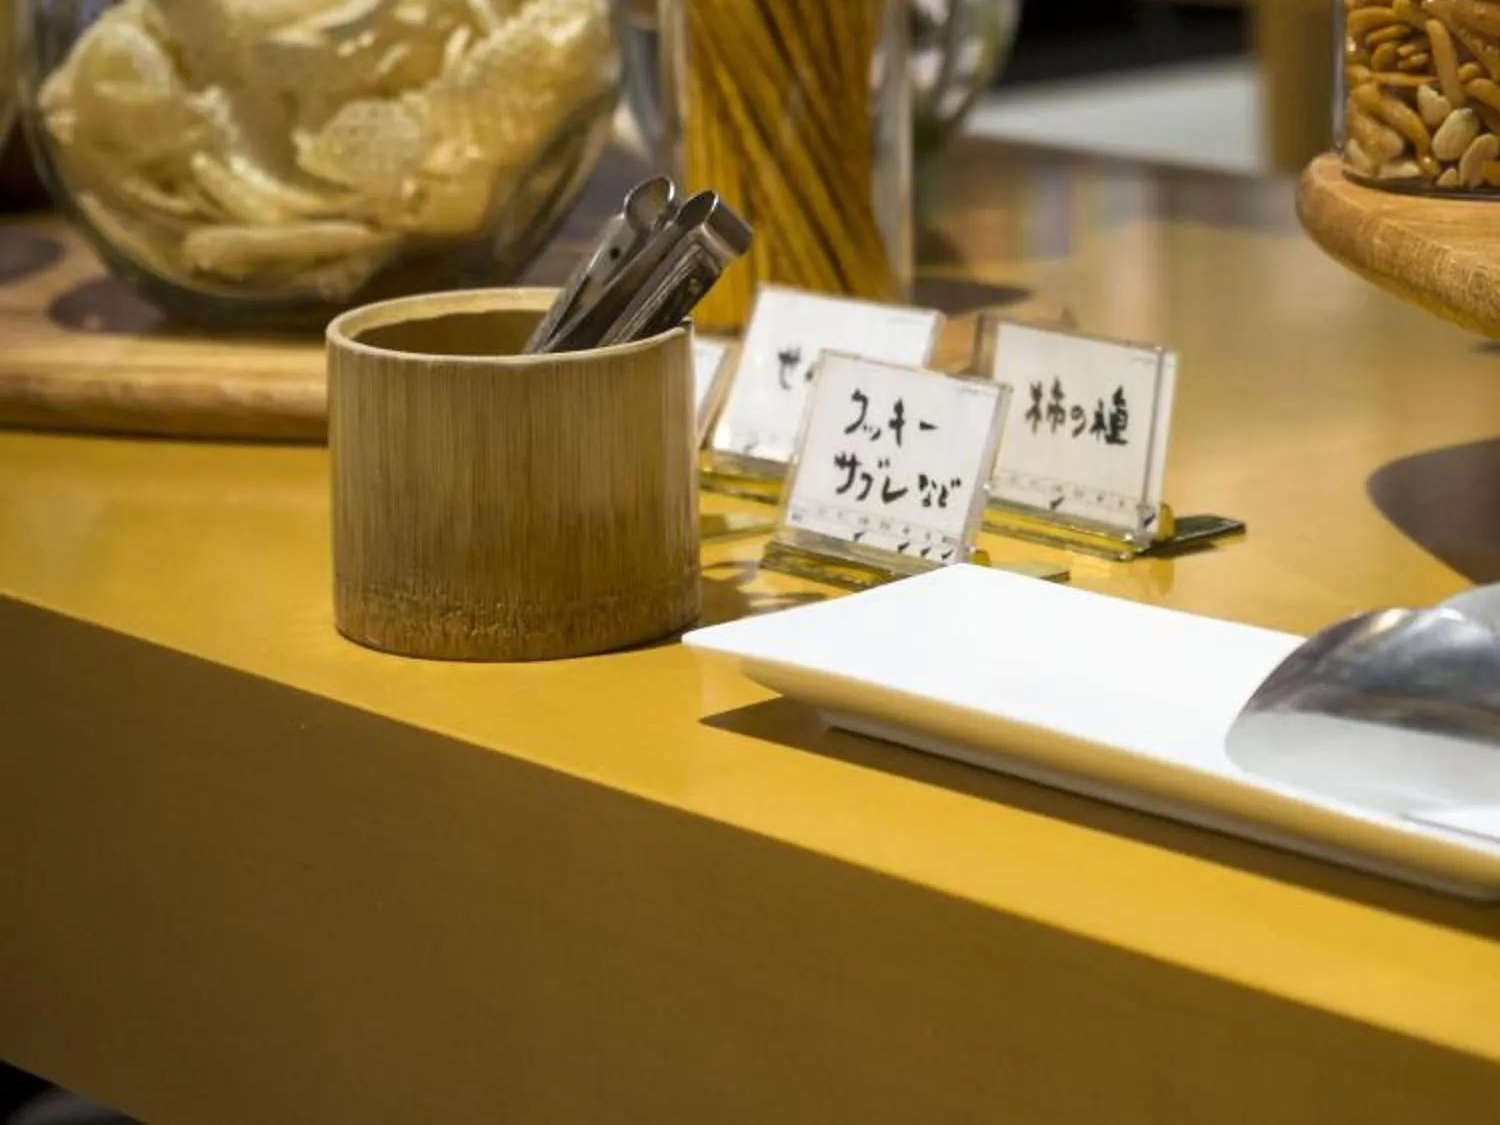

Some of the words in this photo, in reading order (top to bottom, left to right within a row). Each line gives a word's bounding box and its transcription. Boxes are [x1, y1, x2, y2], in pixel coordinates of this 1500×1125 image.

[844, 387, 938, 448] クッキー
[1024, 376, 1130, 446] 柿の種
